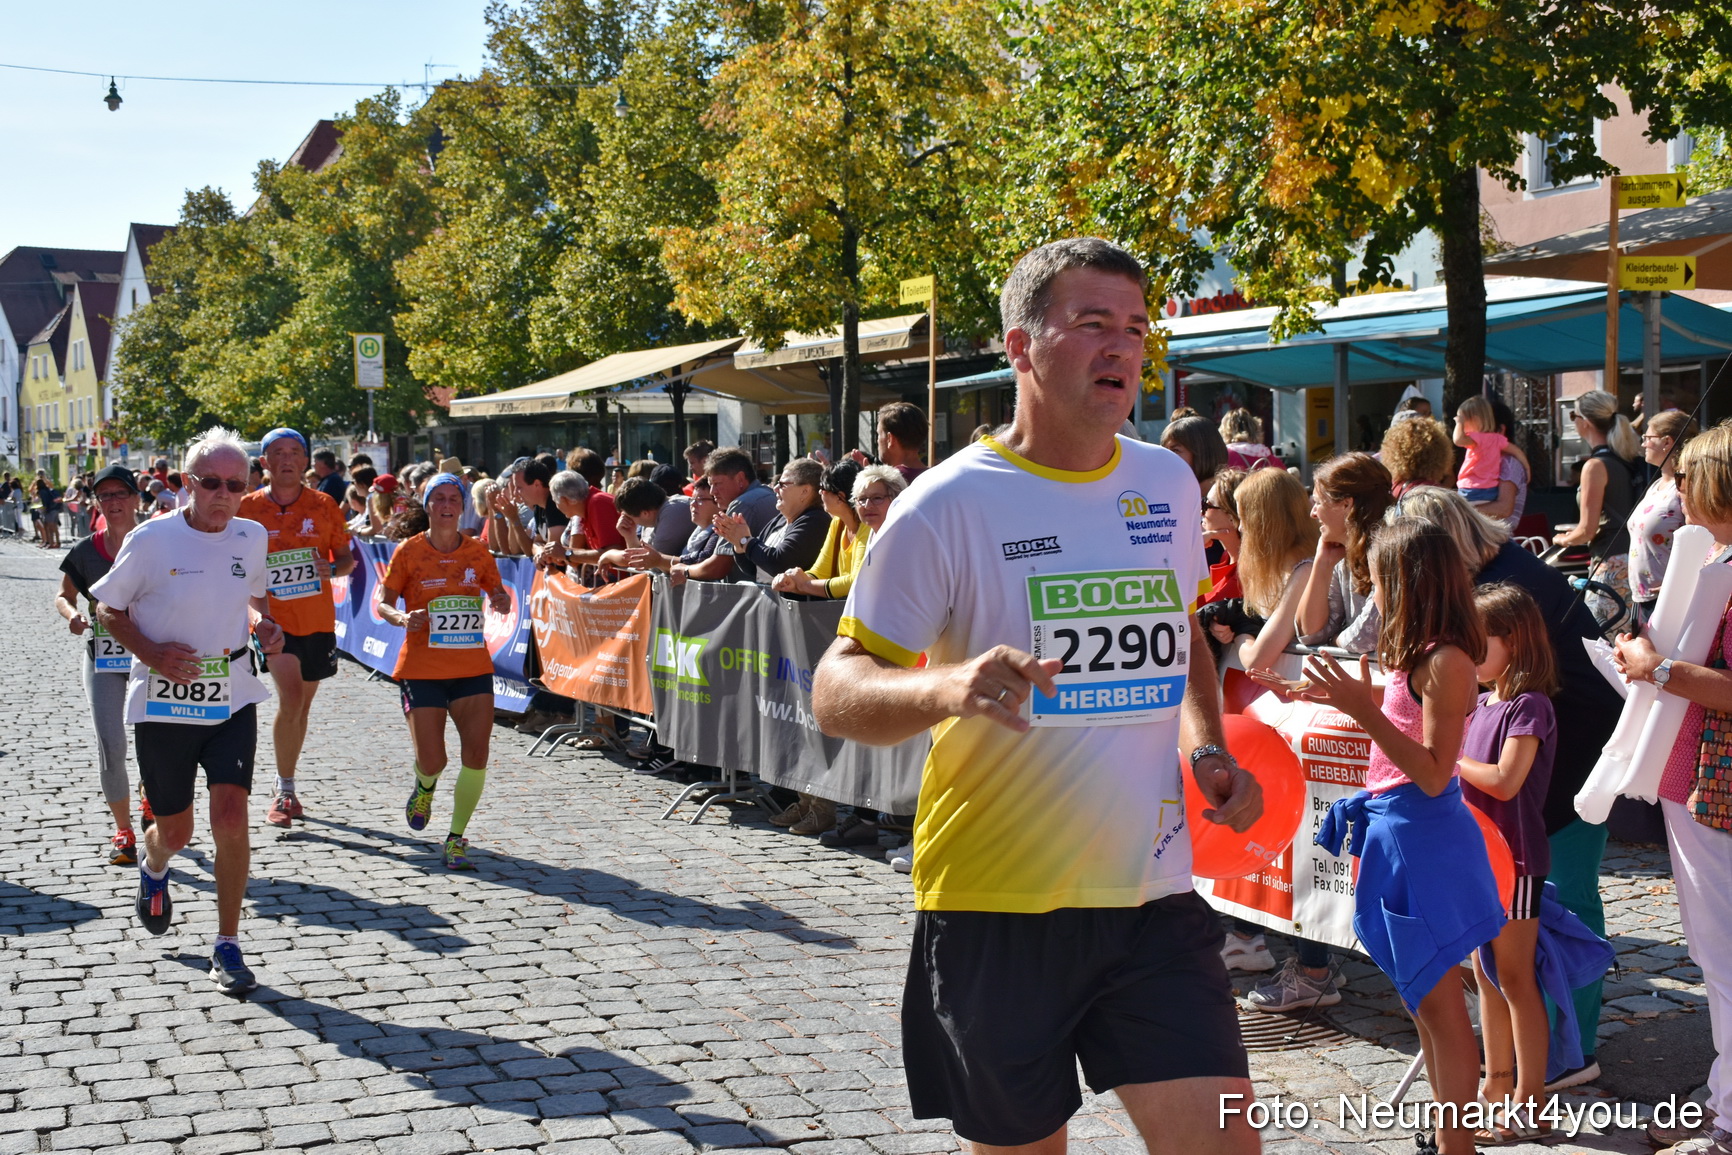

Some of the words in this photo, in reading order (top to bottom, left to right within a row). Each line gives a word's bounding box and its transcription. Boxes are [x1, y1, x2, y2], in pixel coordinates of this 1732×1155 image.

[1628, 194, 1660, 206] ausgabe
[1626, 263, 1679, 272] Kleiderbeutel-
[1636, 275, 1668, 286] ausgabe
[906, 284, 931, 297] Toiletten
[1120, 497, 1148, 518] 20
[1151, 505, 1169, 514] JAHRE
[1126, 519, 1177, 531] Neumarkter
[1003, 537, 1059, 555] BOCK
[1130, 532, 1173, 545] Stadtlauf
[267, 551, 312, 565] BOCK
[271, 565, 315, 585] 2273
[275, 584, 315, 595] BERTRAM
[1045, 575, 1169, 609] BOCK
[434, 600, 478, 609] BOCK
[437, 614, 480, 630] 2272
[1178, 625, 1185, 633] D
[443, 635, 475, 643] BIANKA
[102, 640, 125, 655] 23
[1053, 622, 1176, 674] 2290
[719, 647, 772, 677] OFFIE
[156, 679, 222, 702] 2082
[1059, 684, 1172, 710] HERBERT
[171, 705, 206, 717] WILLI
[1308, 737, 1370, 757] RUNDSCHL
[1310, 764, 1369, 784] HEBEBÄN
[1313, 797, 1333, 811] Bra
[1313, 858, 1331, 874] Tel.
[1333, 861, 1352, 878] 091
[1262, 872, 1272, 887] ist
[1272, 875, 1294, 893] sicher
[1314, 876, 1331, 891] Fax
[1334, 879, 1355, 897] 0918
